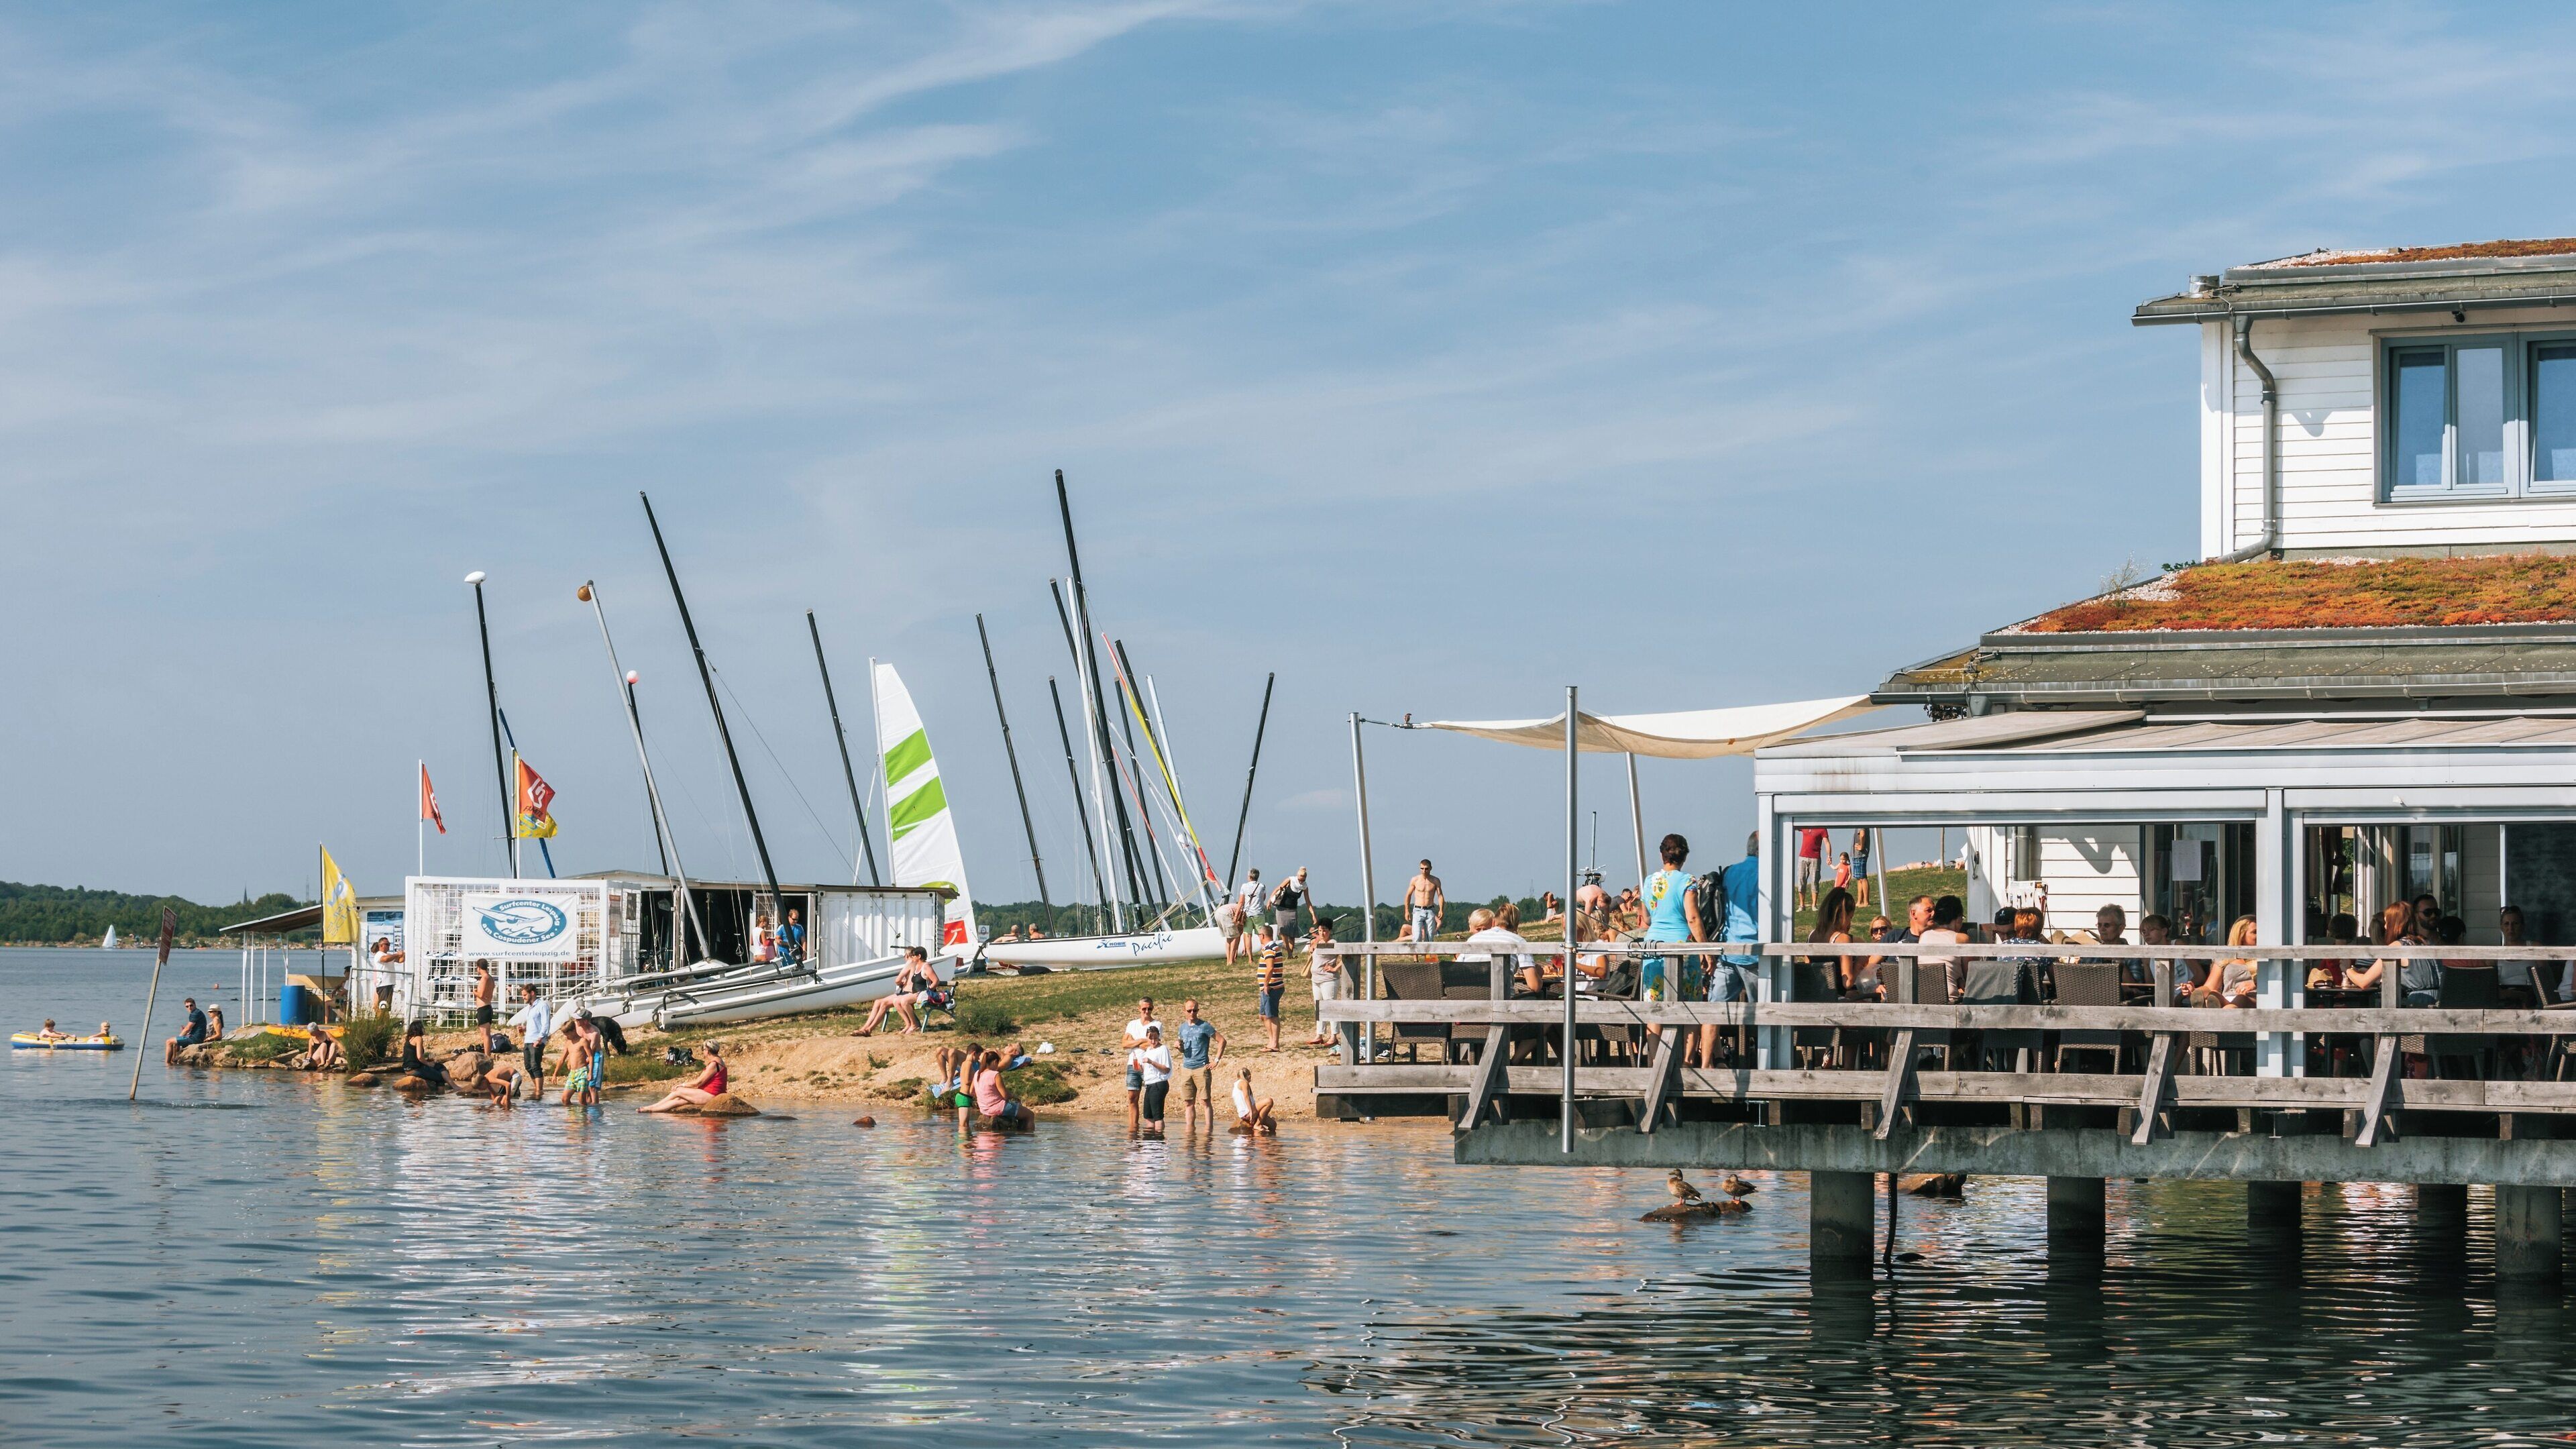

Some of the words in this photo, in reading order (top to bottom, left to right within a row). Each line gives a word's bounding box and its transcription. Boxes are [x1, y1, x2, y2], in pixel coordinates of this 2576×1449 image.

[499, 900, 540, 911] Surfcenter
[541, 904, 560, 926] Leipzig
[482, 923, 492, 935] am
[493, 932, 539, 943] Cospudener
[541, 932, 555, 941] See
[1132, 933, 1174, 956] Pacific
